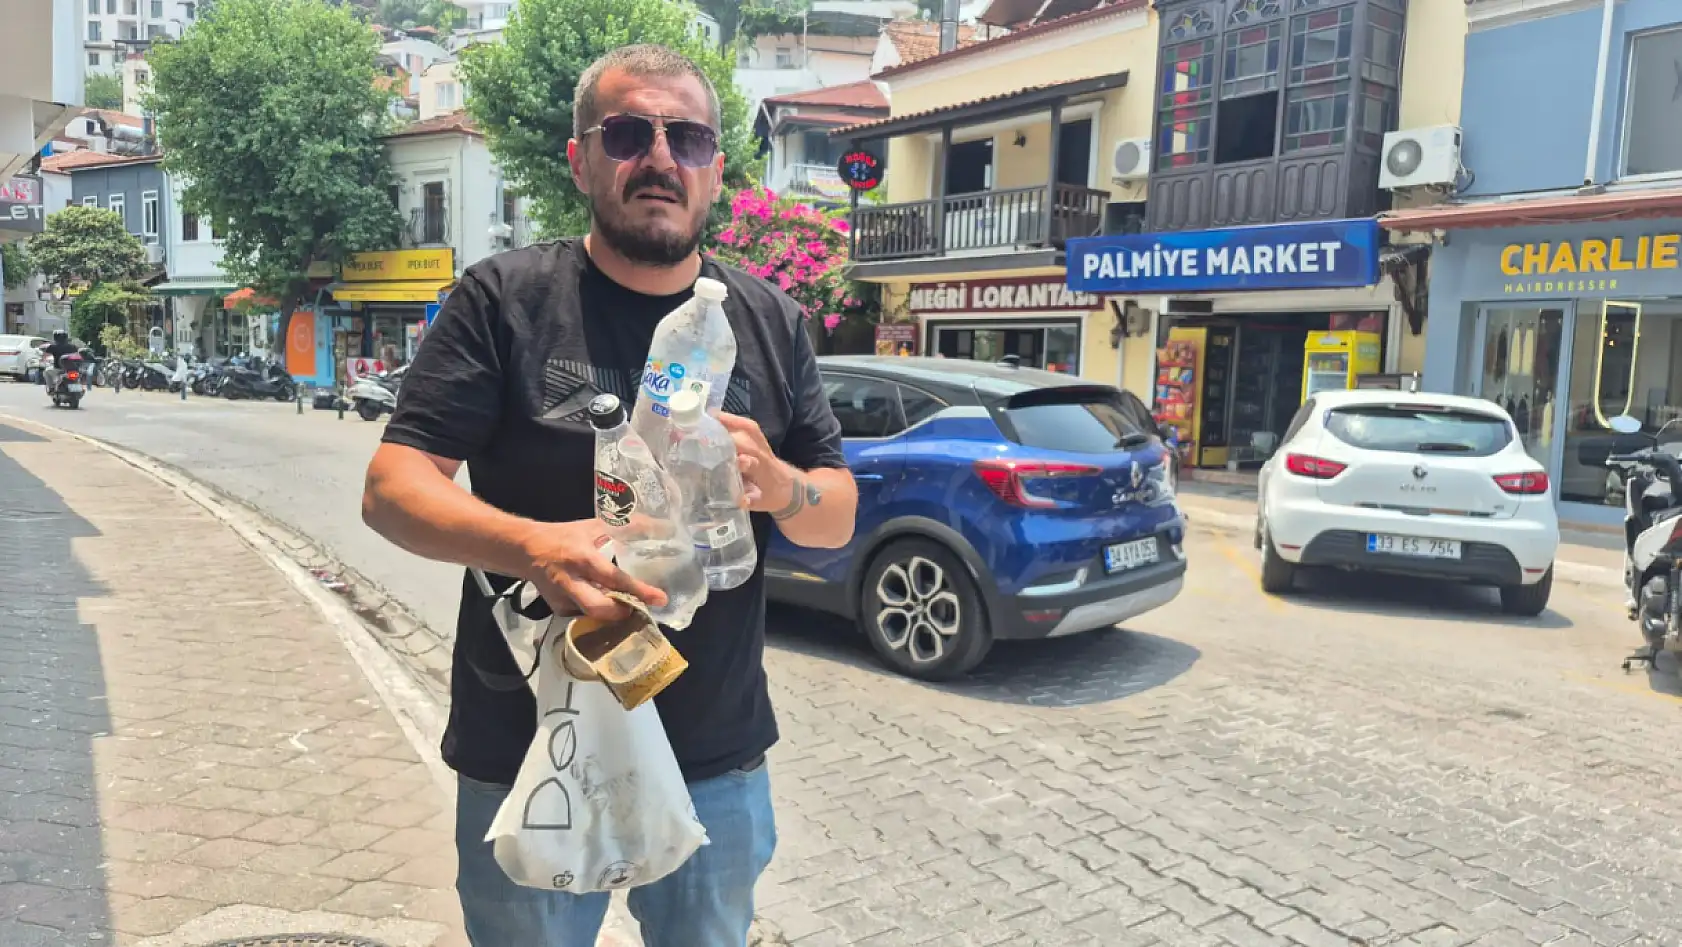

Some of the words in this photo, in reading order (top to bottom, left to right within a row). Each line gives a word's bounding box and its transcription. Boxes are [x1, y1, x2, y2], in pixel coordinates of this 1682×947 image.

[1083, 243, 1199, 280] PALMİYE
[1206, 241, 1341, 276] MARKET
[1500, 233, 1682, 276] CHARLIE
[910, 282, 967, 310] MEĞRİ
[1504, 279, 1617, 293] HAIRDRESSER
[1402, 540, 1419, 552] ES
[1429, 541, 1454, 555] 754
